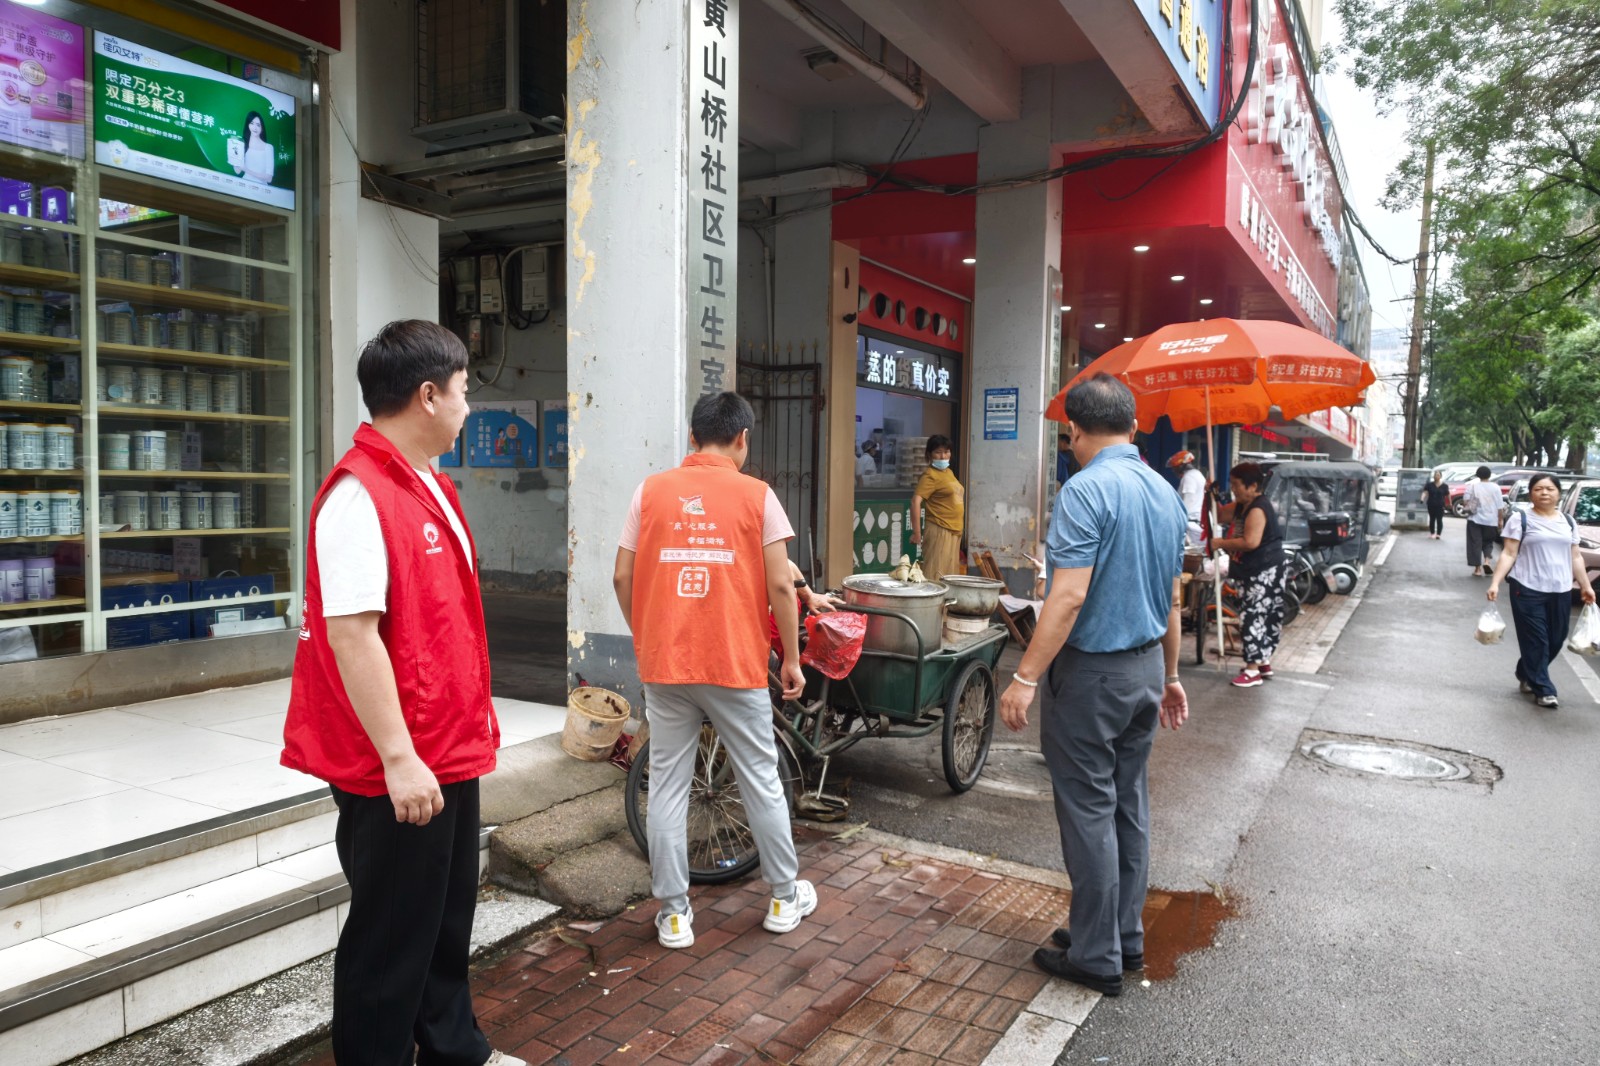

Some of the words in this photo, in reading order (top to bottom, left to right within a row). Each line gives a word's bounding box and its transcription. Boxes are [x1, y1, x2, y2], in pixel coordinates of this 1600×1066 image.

[103, 42, 140, 61] 佳贝艾特
[105, 68, 184, 103] 限定万分之3
[867, 350, 950, 396] 蒸的货真价实
[1145, 371, 1178, 385] 好记星
